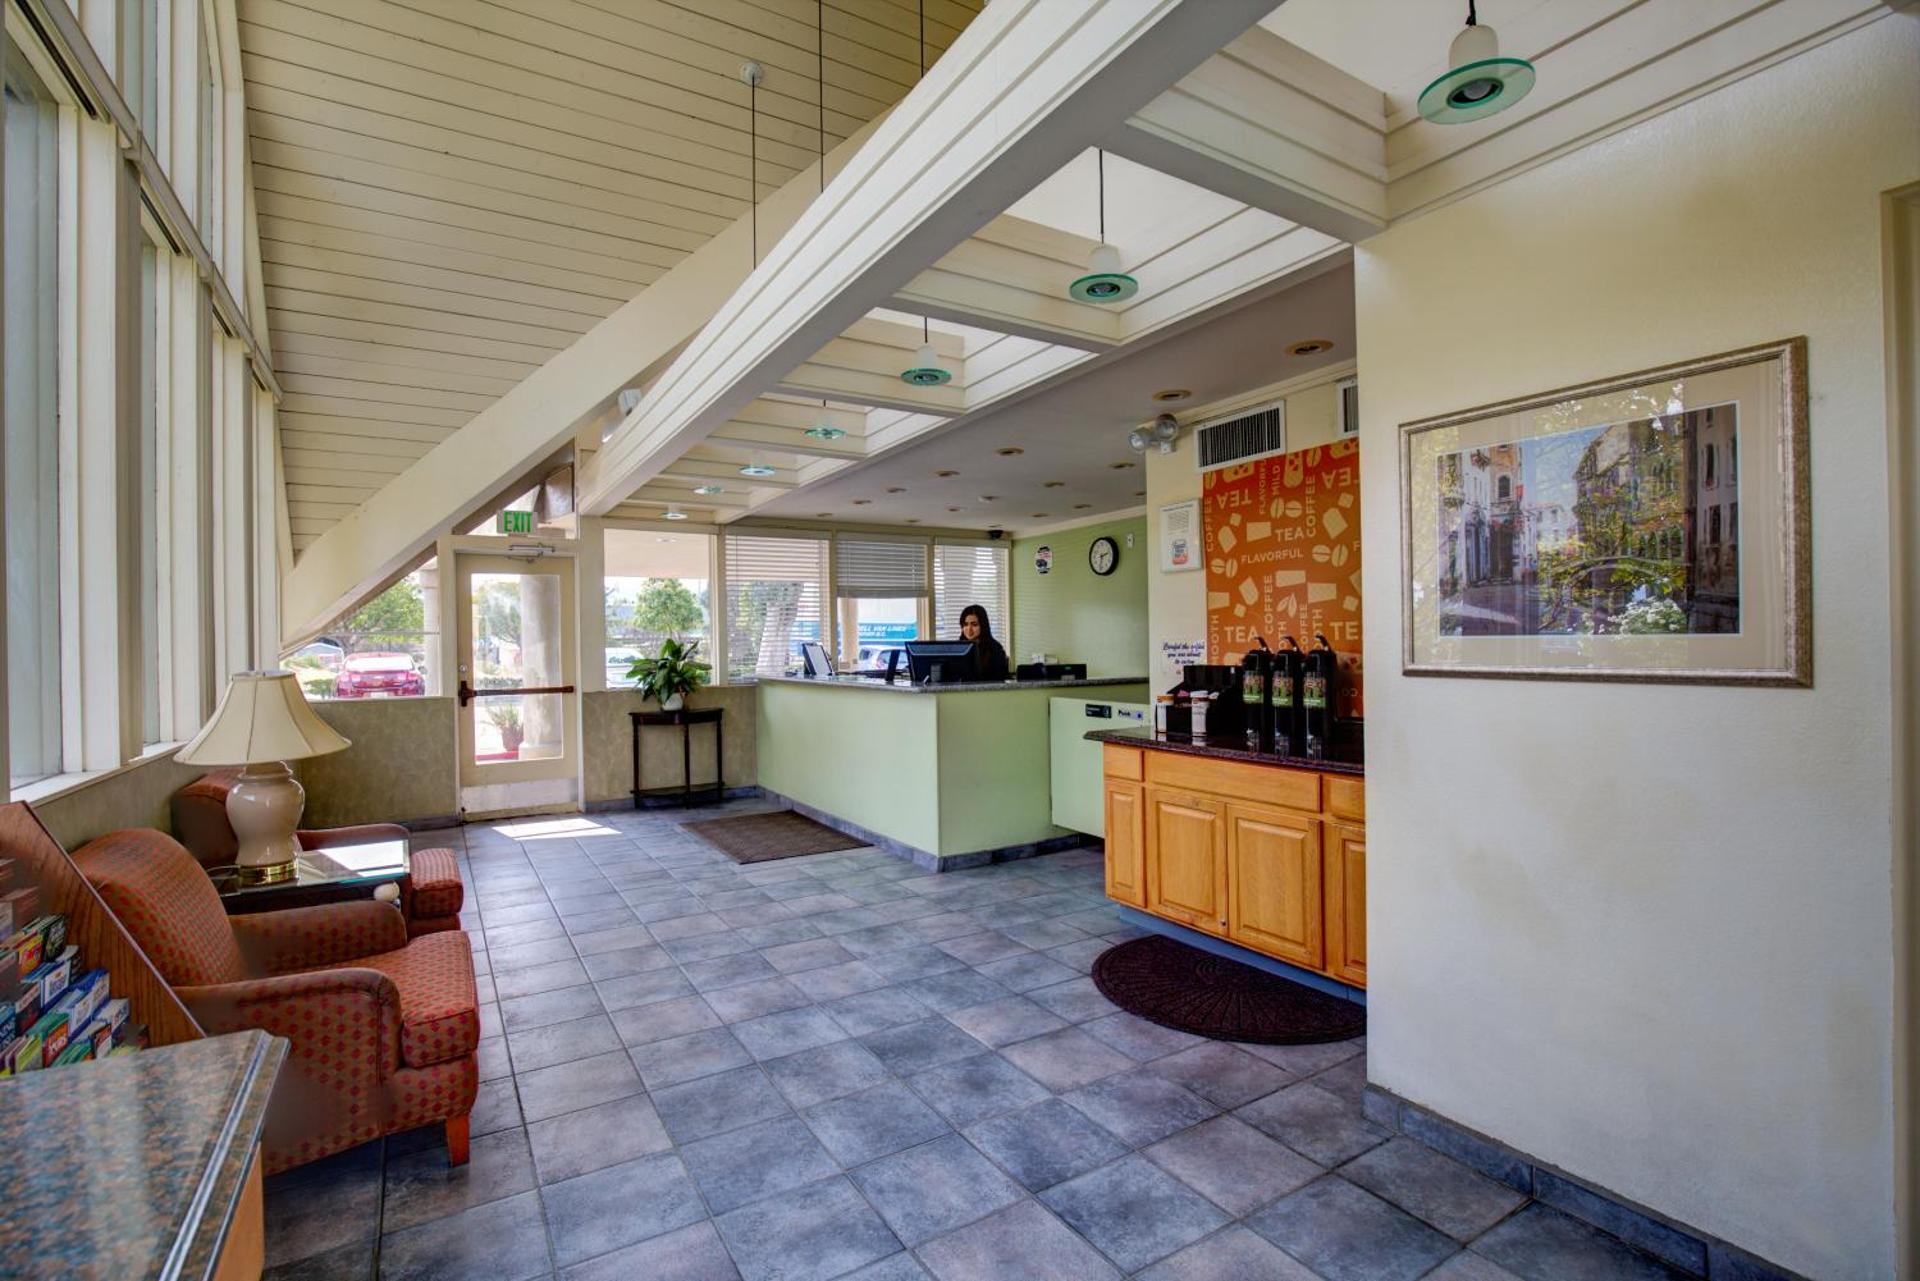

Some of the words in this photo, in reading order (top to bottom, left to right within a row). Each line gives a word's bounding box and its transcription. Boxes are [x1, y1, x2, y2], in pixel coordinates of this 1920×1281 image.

[1272, 465, 1280, 496] MILD
[1322, 467, 1360, 489] EA
[1216, 488, 1252, 509] TEA
[1305, 475, 1316, 537] COFFEE
[503, 511, 532, 533] EXIT
[1204, 497, 1214, 552] COFFEE
[1275, 526, 1304, 542] TEA
[1241, 549, 1304, 564] FLAVORFUL
[1264, 575, 1273, 634] COFFEE
[1224, 625, 1259, 643] TEA
[1329, 621, 1359, 641] TE
